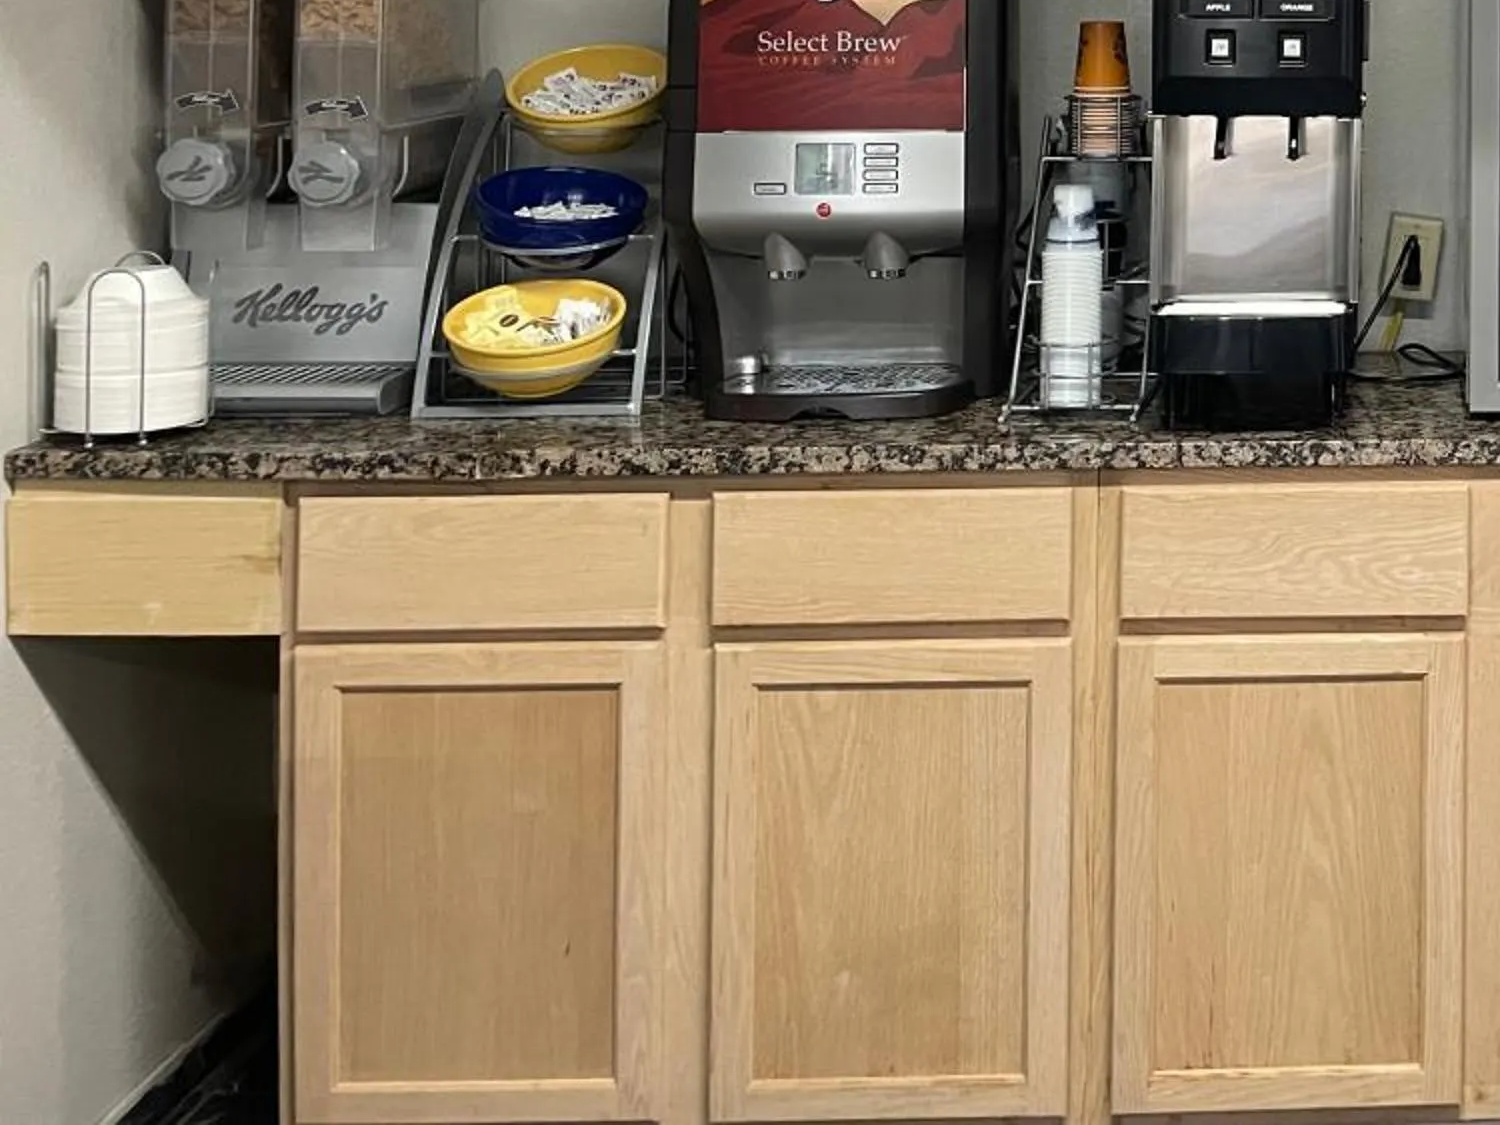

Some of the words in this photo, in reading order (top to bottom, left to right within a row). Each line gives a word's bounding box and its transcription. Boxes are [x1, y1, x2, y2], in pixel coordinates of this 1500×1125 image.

[1205, 3, 1231, 12] APPLE
[1280, 3, 1314, 12] ORANGE
[757, 30, 829, 53] Select
[836, 30, 902, 53] Brew
[758, 55, 819, 66] COFFEE
[231, 282, 389, 337] Kellogg's
